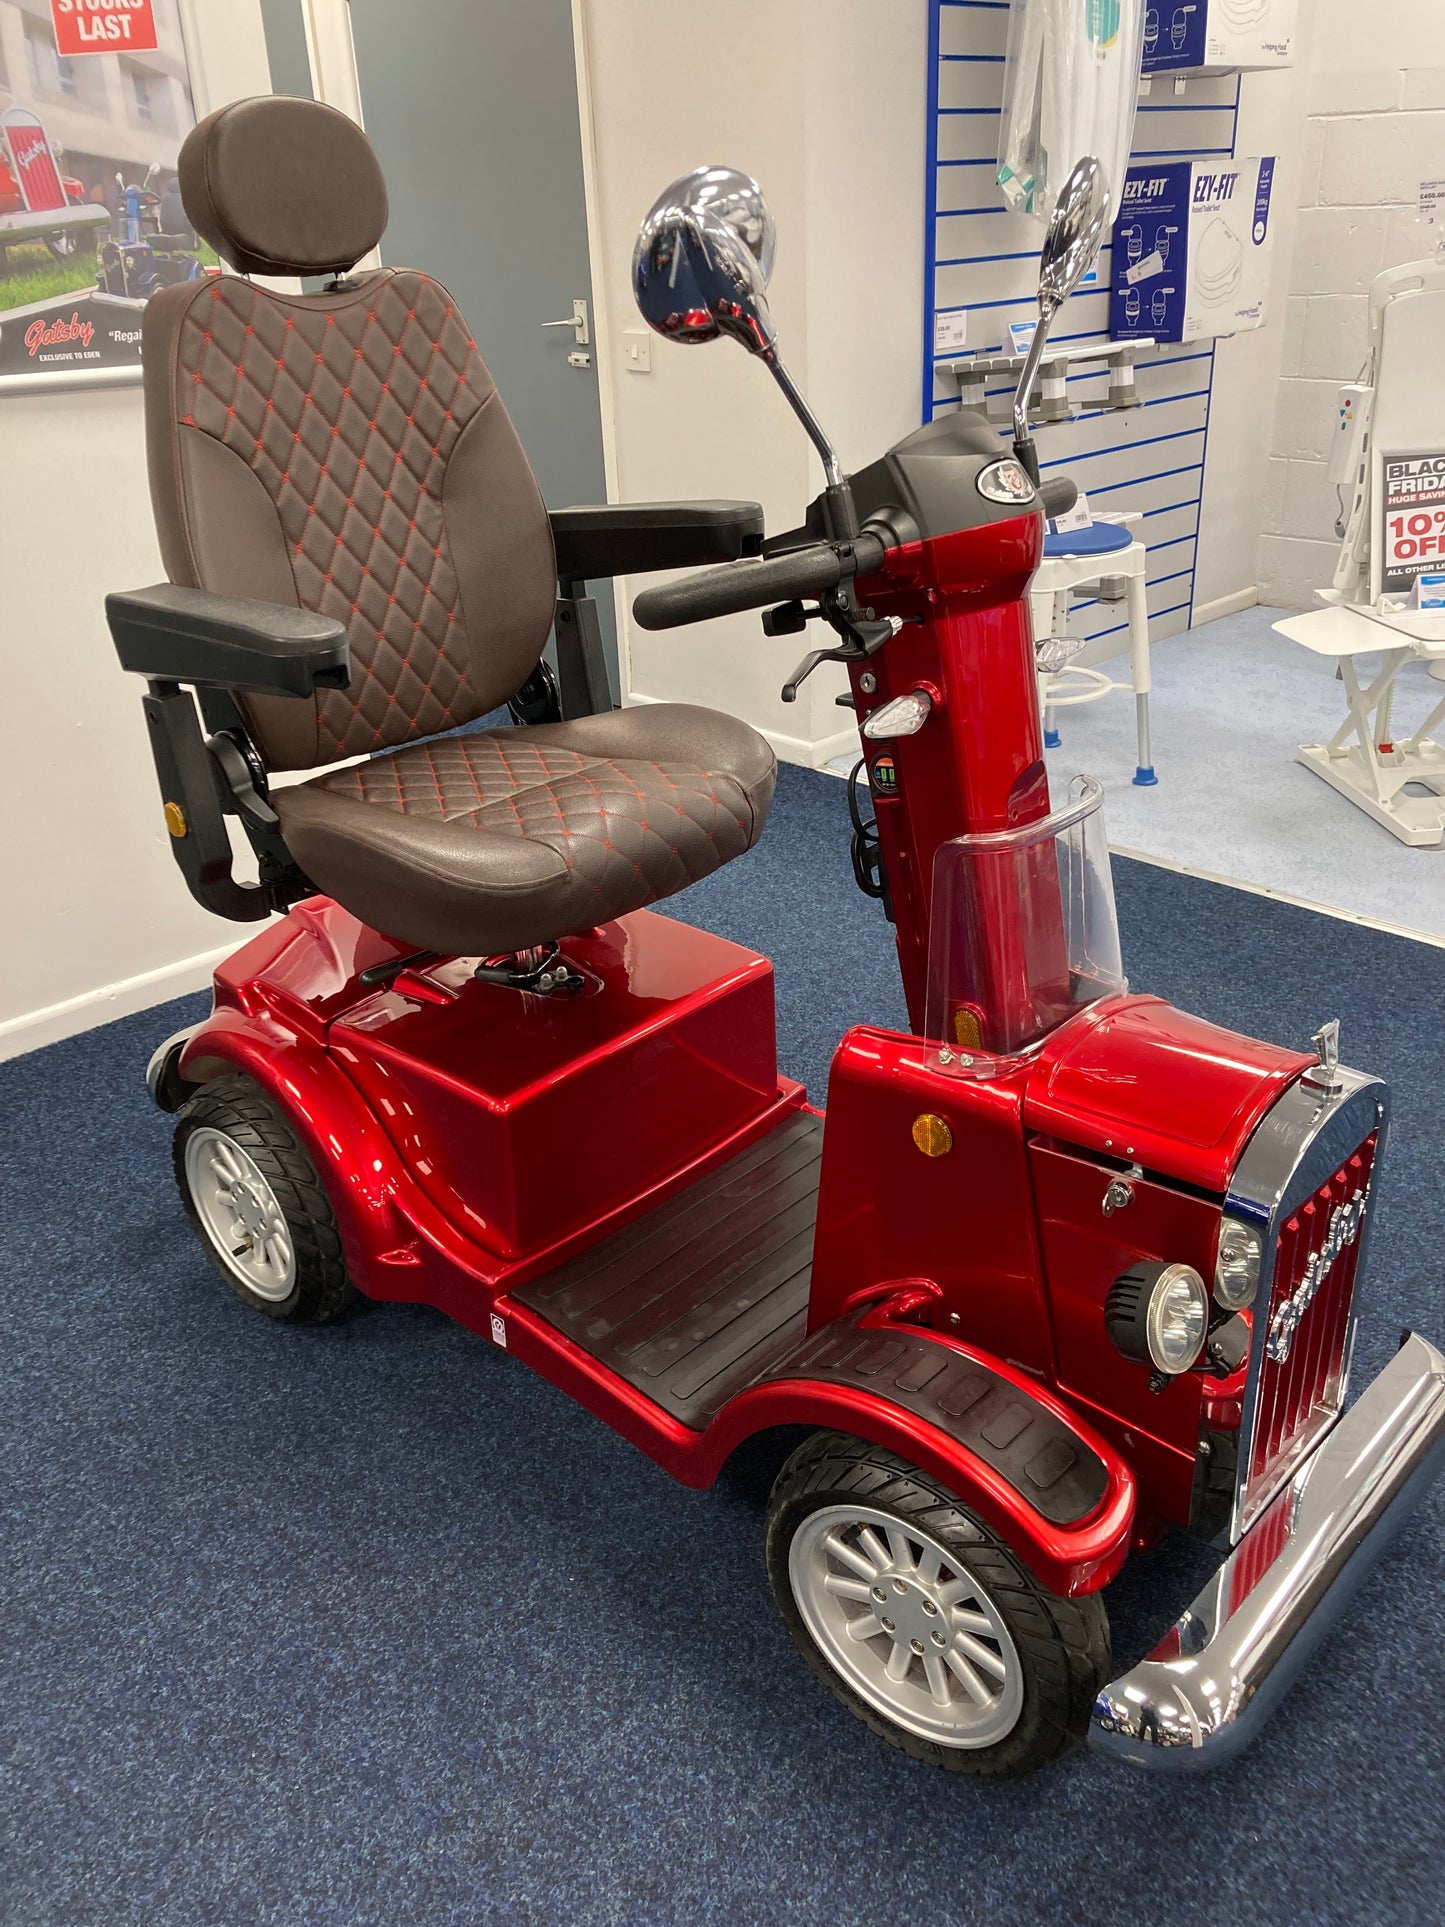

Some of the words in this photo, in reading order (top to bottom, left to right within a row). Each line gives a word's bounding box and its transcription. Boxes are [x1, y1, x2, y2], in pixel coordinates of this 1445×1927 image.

[76, 14, 132, 41] LAST
[1123, 178, 1168, 199] EZY-FIT
[1193, 172, 1240, 203] EZY-FIT
[24, 311, 95, 356] Gatsby
[39, 352, 73, 362] EXCLUSIVE
[74, 352, 83, 360] TO
[84, 350, 100, 359] EDEN
[1388, 494, 1417, 505] HUGE
[1405, 564, 1434, 574] OTHER
